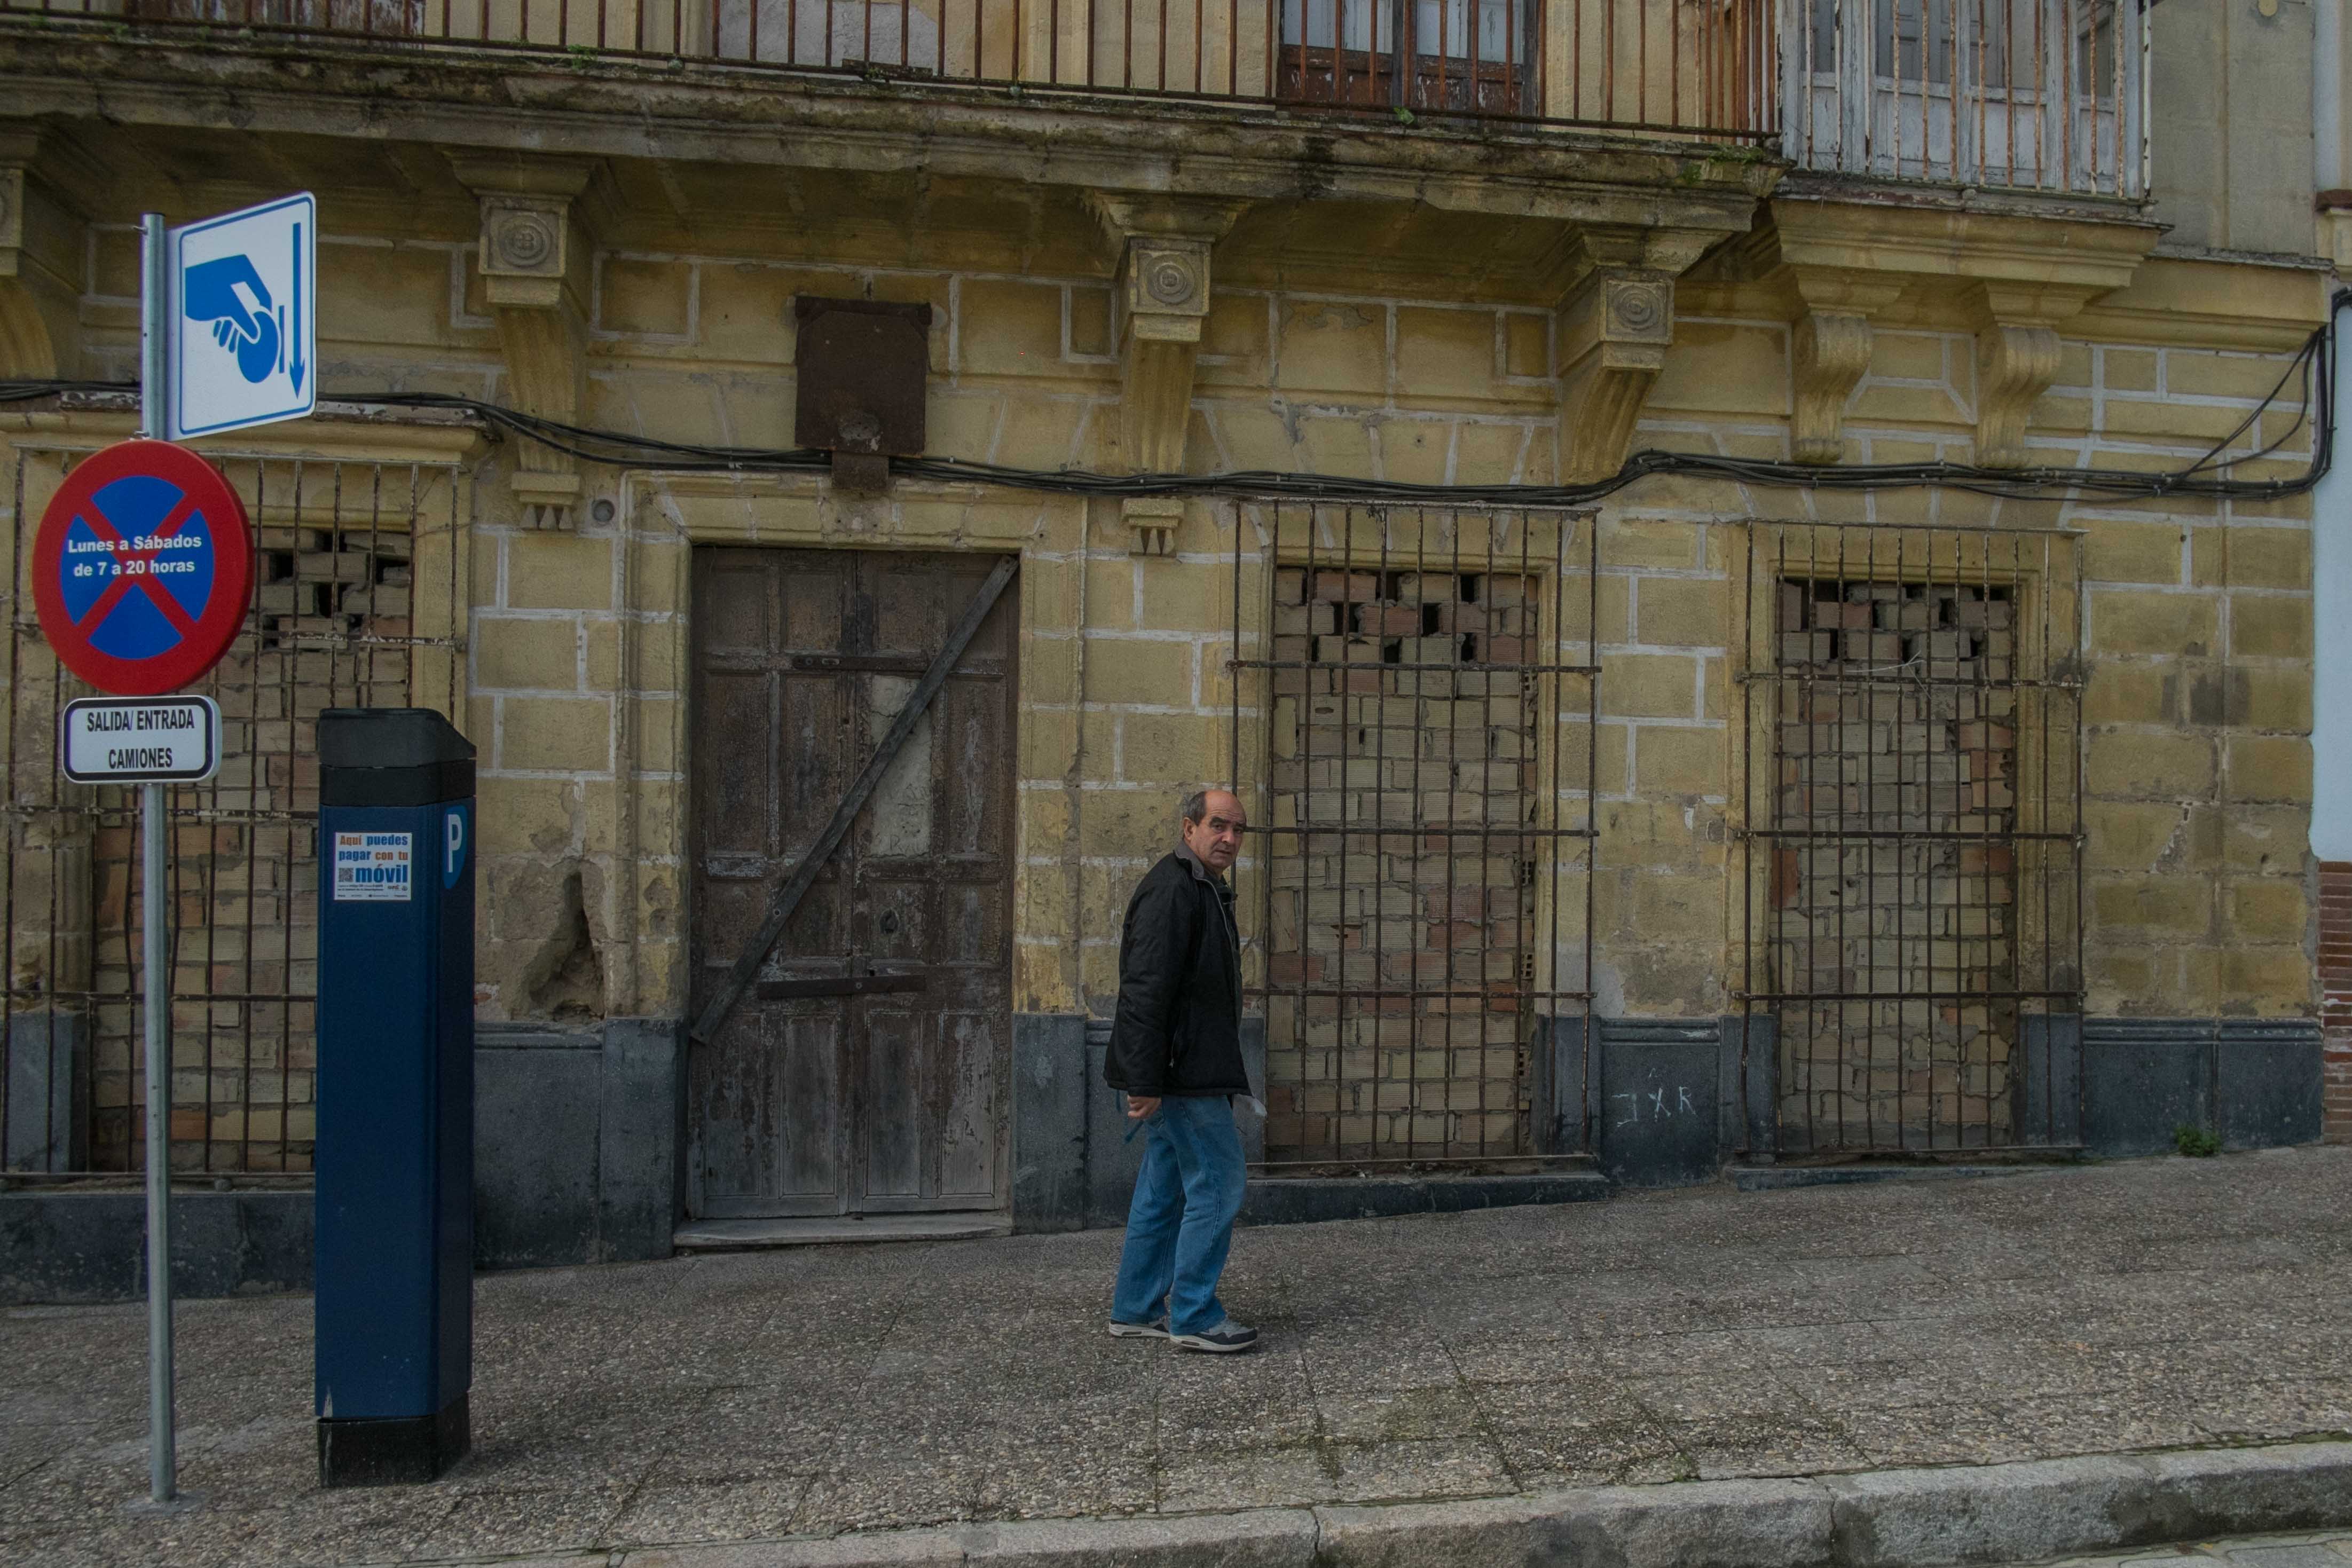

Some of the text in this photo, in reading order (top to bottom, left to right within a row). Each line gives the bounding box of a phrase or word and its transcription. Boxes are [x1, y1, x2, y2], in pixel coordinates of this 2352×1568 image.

[68, 534, 202, 554] Lunes a Sábados
[74, 560, 195, 577] de 7 a 20 horas
[87, 709, 195, 732] SALIDA/ ENTRADA
[108, 747, 172, 769] CAMIONES
[340, 834, 408, 846] Aquí puedes
[447, 814, 463, 873] P
[339, 850, 408, 862] pagar con tu
[356, 863, 408, 883] móvil
